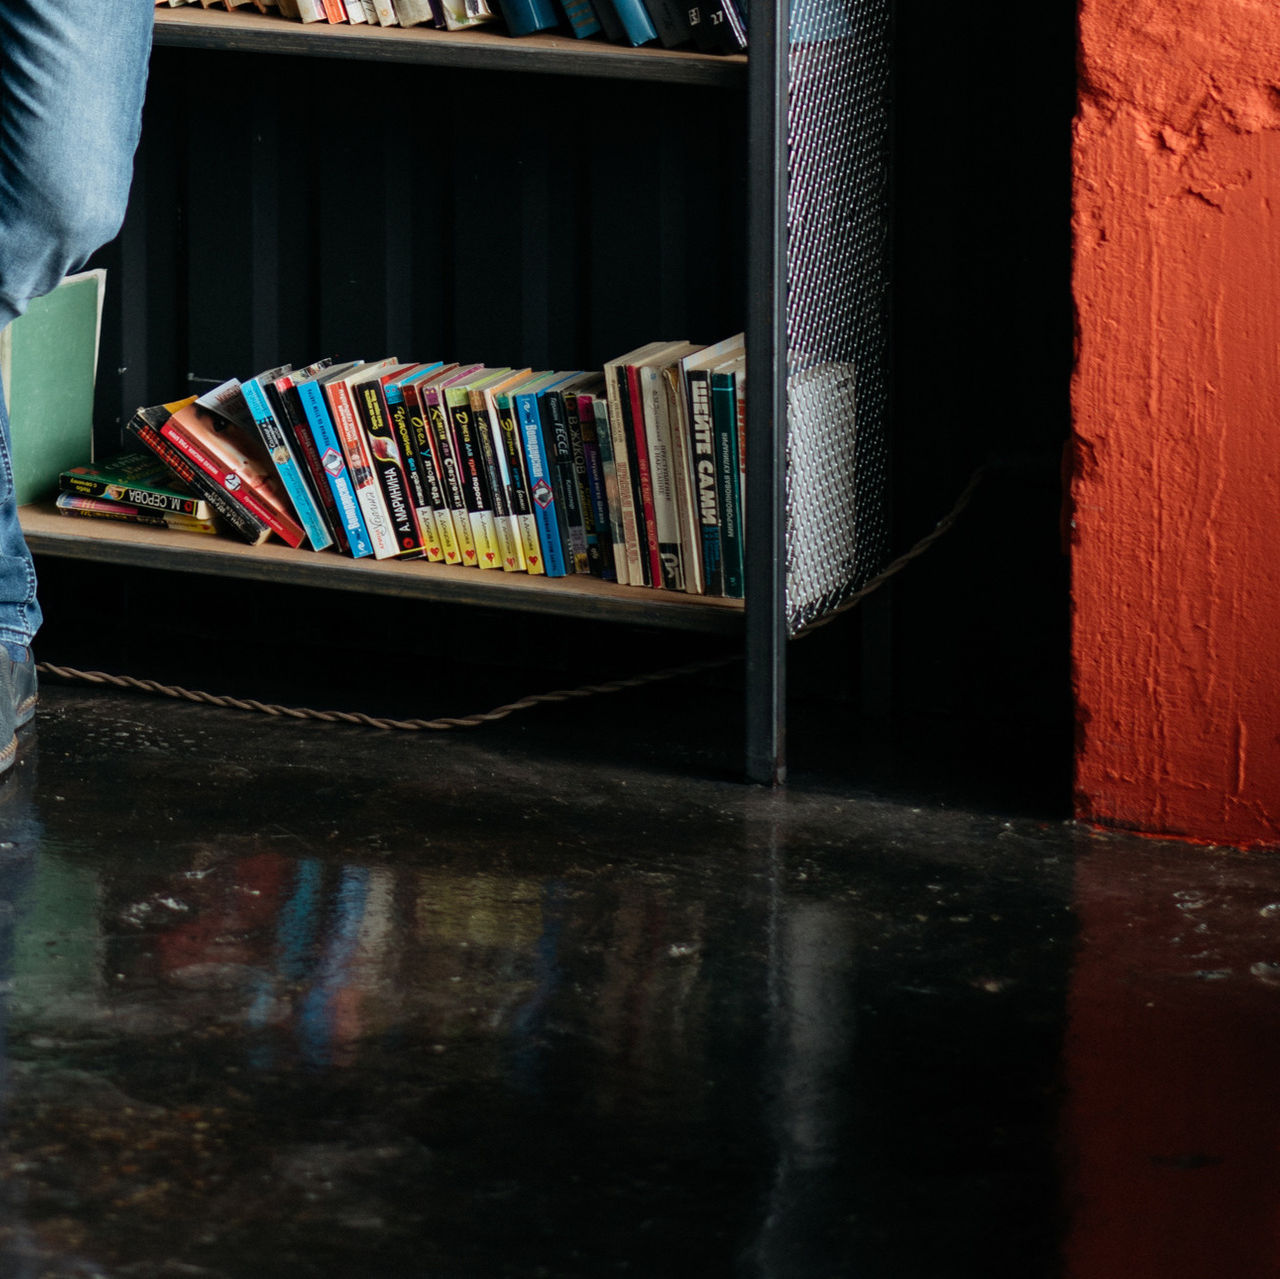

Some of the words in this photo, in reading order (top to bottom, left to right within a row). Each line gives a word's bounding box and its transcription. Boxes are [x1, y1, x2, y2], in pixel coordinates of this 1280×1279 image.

[553, 422, 568, 455] ГЕССЕ
[691, 380, 712, 454] ШЕЙТЕ
[526, 424, 543, 478] Володарская
[568, 415, 585, 474] В.ЖУКОВ
[720, 432, 730, 474] КУЛИНАРИЯ
[128, 488, 168, 506] СЕРОВА
[384, 467, 407, 519] МАРИНИНА
[424, 460, 441, 505] людоеда
[473, 477, 484, 509] поросят
[655, 452, 664, 496] НАКАЗАНИЕ
[660, 445, 671, 502] ПРЕСТУПЛЕНИЕ
[698, 460, 721, 525] САМИ
[169, 498, 182, 510] М.
[333, 476, 362, 530] Володарская
[395, 521, 411, 532] А.
[723, 475, 735, 538] МИКРОВОЛНОВАЯ
